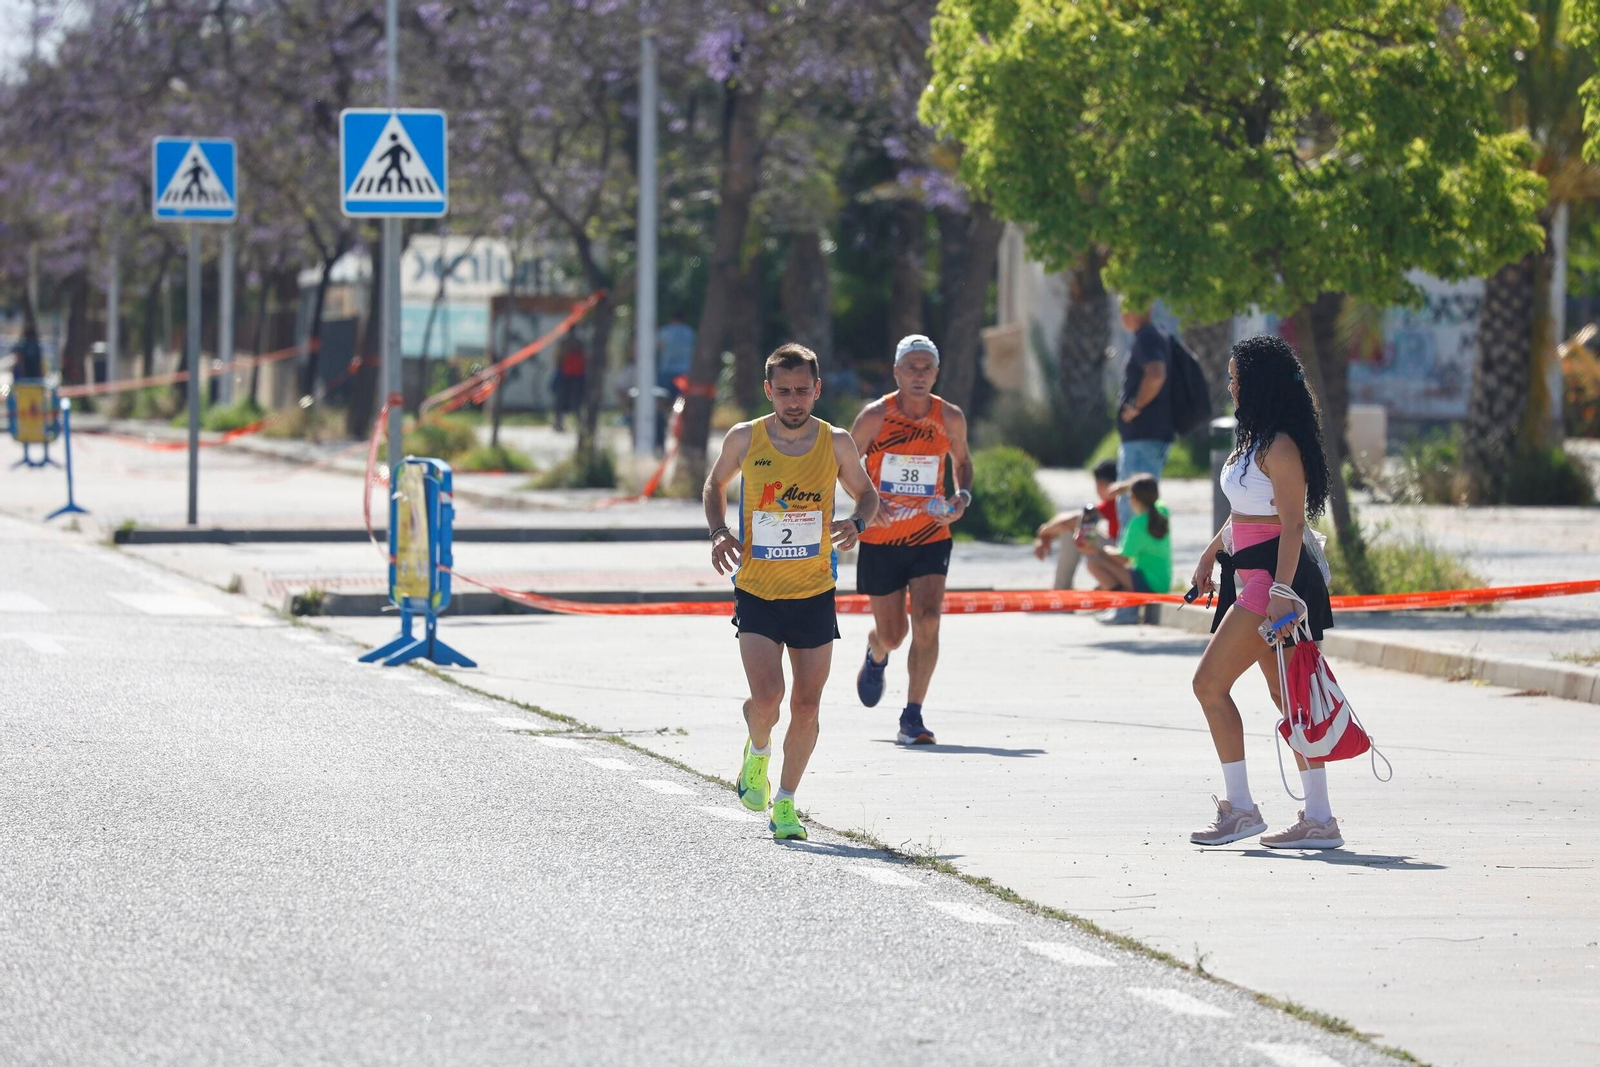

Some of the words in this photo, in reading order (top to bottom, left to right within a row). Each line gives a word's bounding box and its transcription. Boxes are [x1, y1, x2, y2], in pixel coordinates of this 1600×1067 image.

[900, 468, 919, 482] 38
[781, 483, 823, 503] Álora
[781, 528, 793, 544] 2
